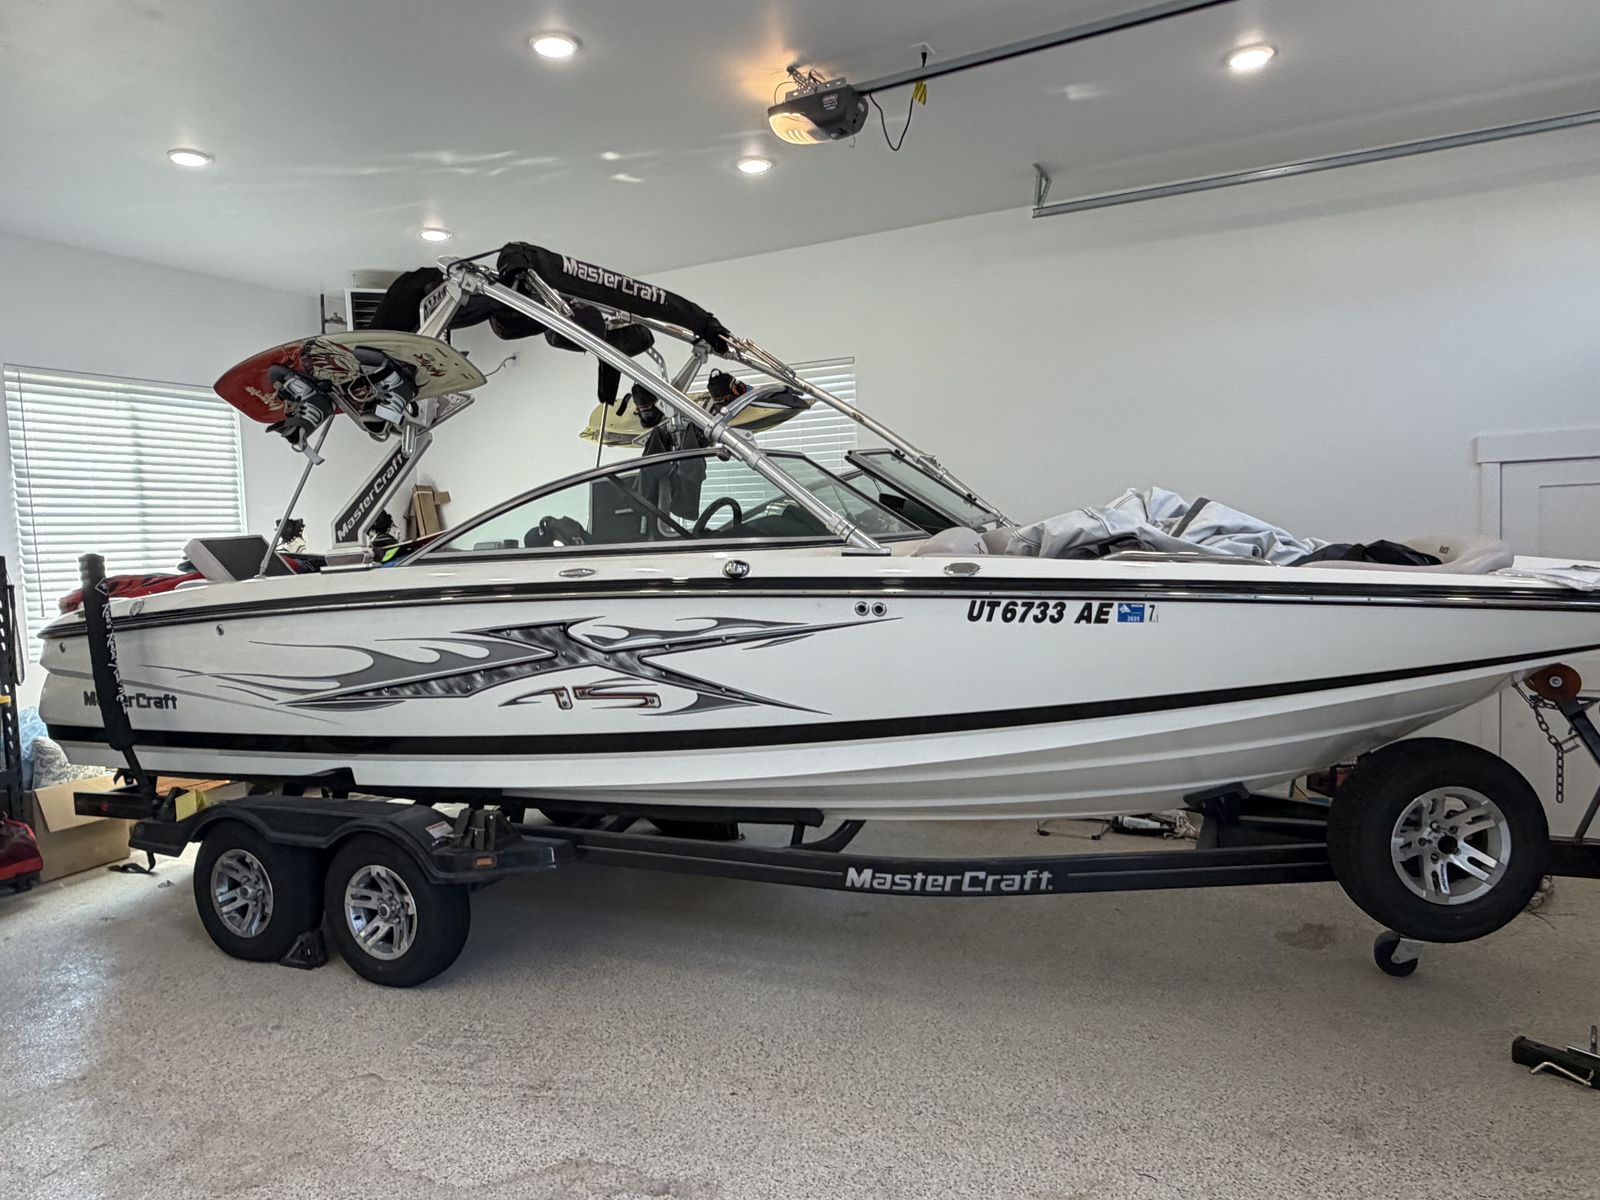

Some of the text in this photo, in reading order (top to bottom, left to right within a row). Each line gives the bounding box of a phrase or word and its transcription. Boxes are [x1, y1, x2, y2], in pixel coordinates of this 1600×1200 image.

[562, 255, 666, 304] MasterCraft
[337, 453, 403, 541] MasterCraft
[1074, 602, 1114, 624] AE
[83, 690, 177, 710] MerCraft
